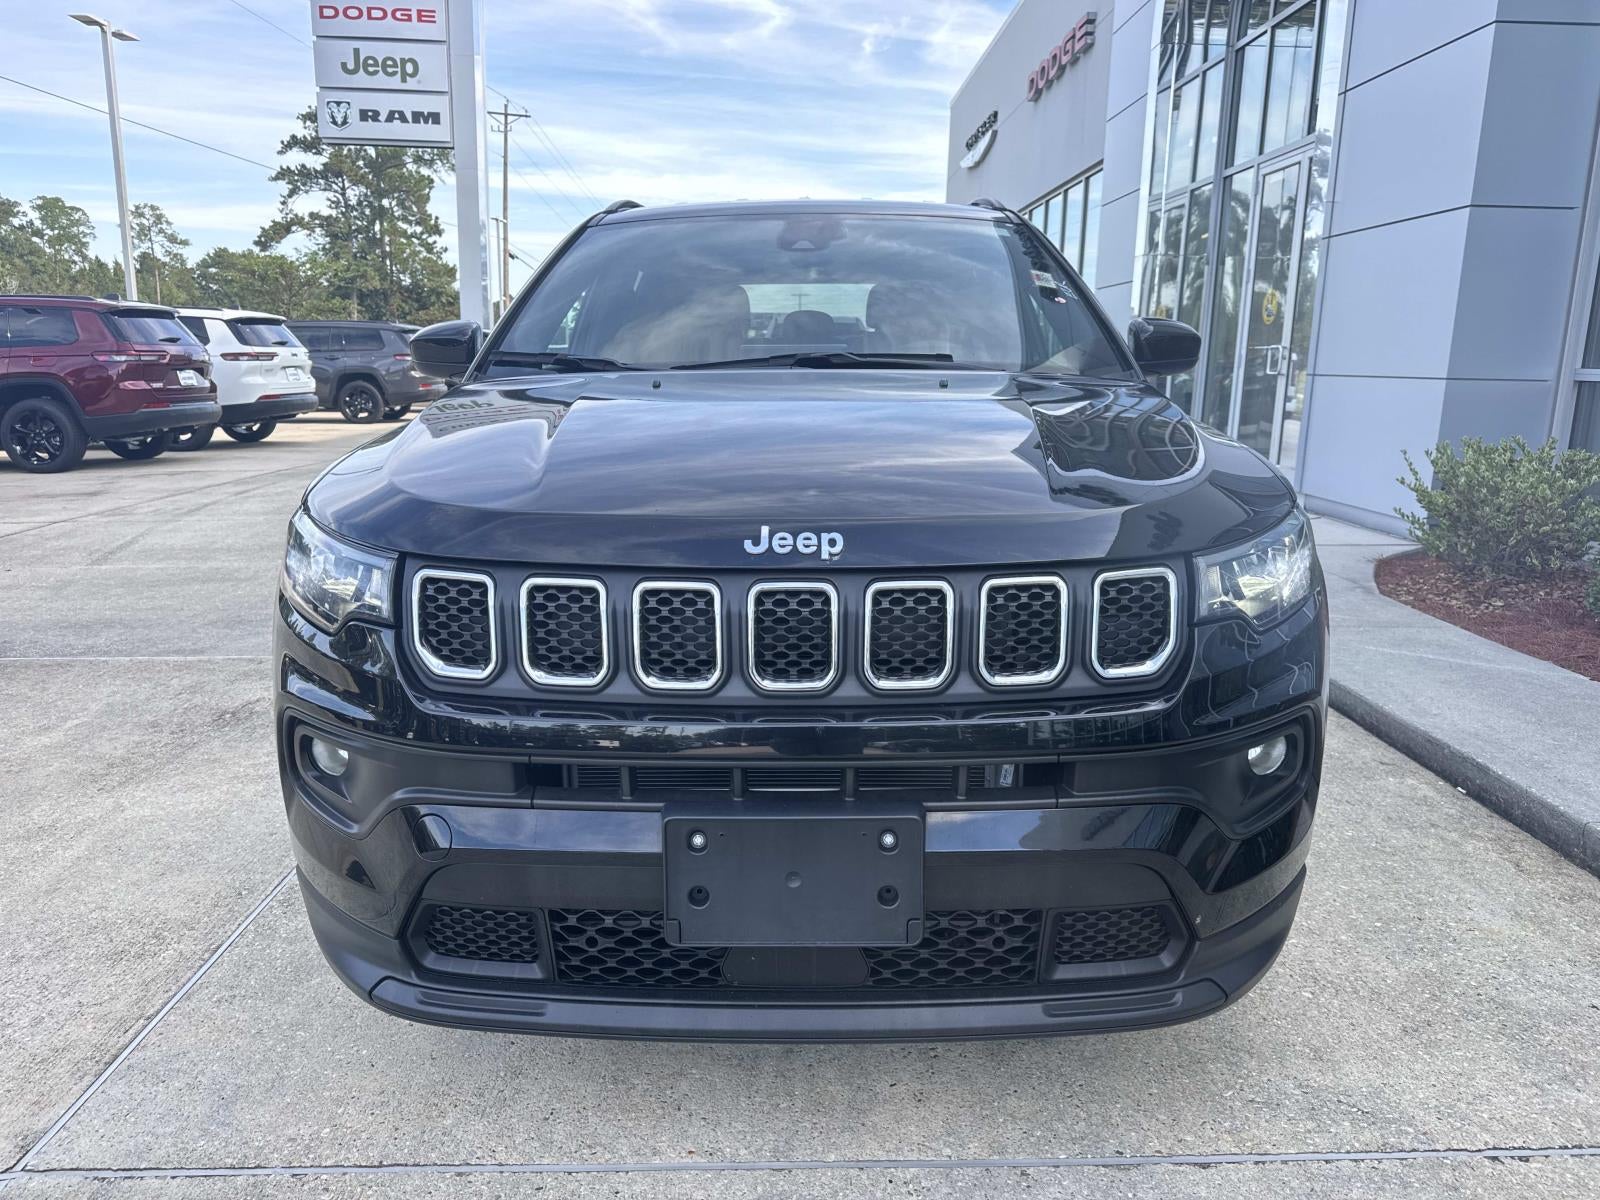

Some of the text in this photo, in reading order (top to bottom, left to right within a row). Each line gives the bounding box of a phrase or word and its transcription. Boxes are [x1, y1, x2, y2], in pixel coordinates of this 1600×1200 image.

[318, 5, 437, 24] DODGE
[340, 47, 419, 83] Jeep
[1026, 12, 1097, 102] DODGE
[359, 108, 441, 125] RAM
[743, 525, 844, 560] Jeep
